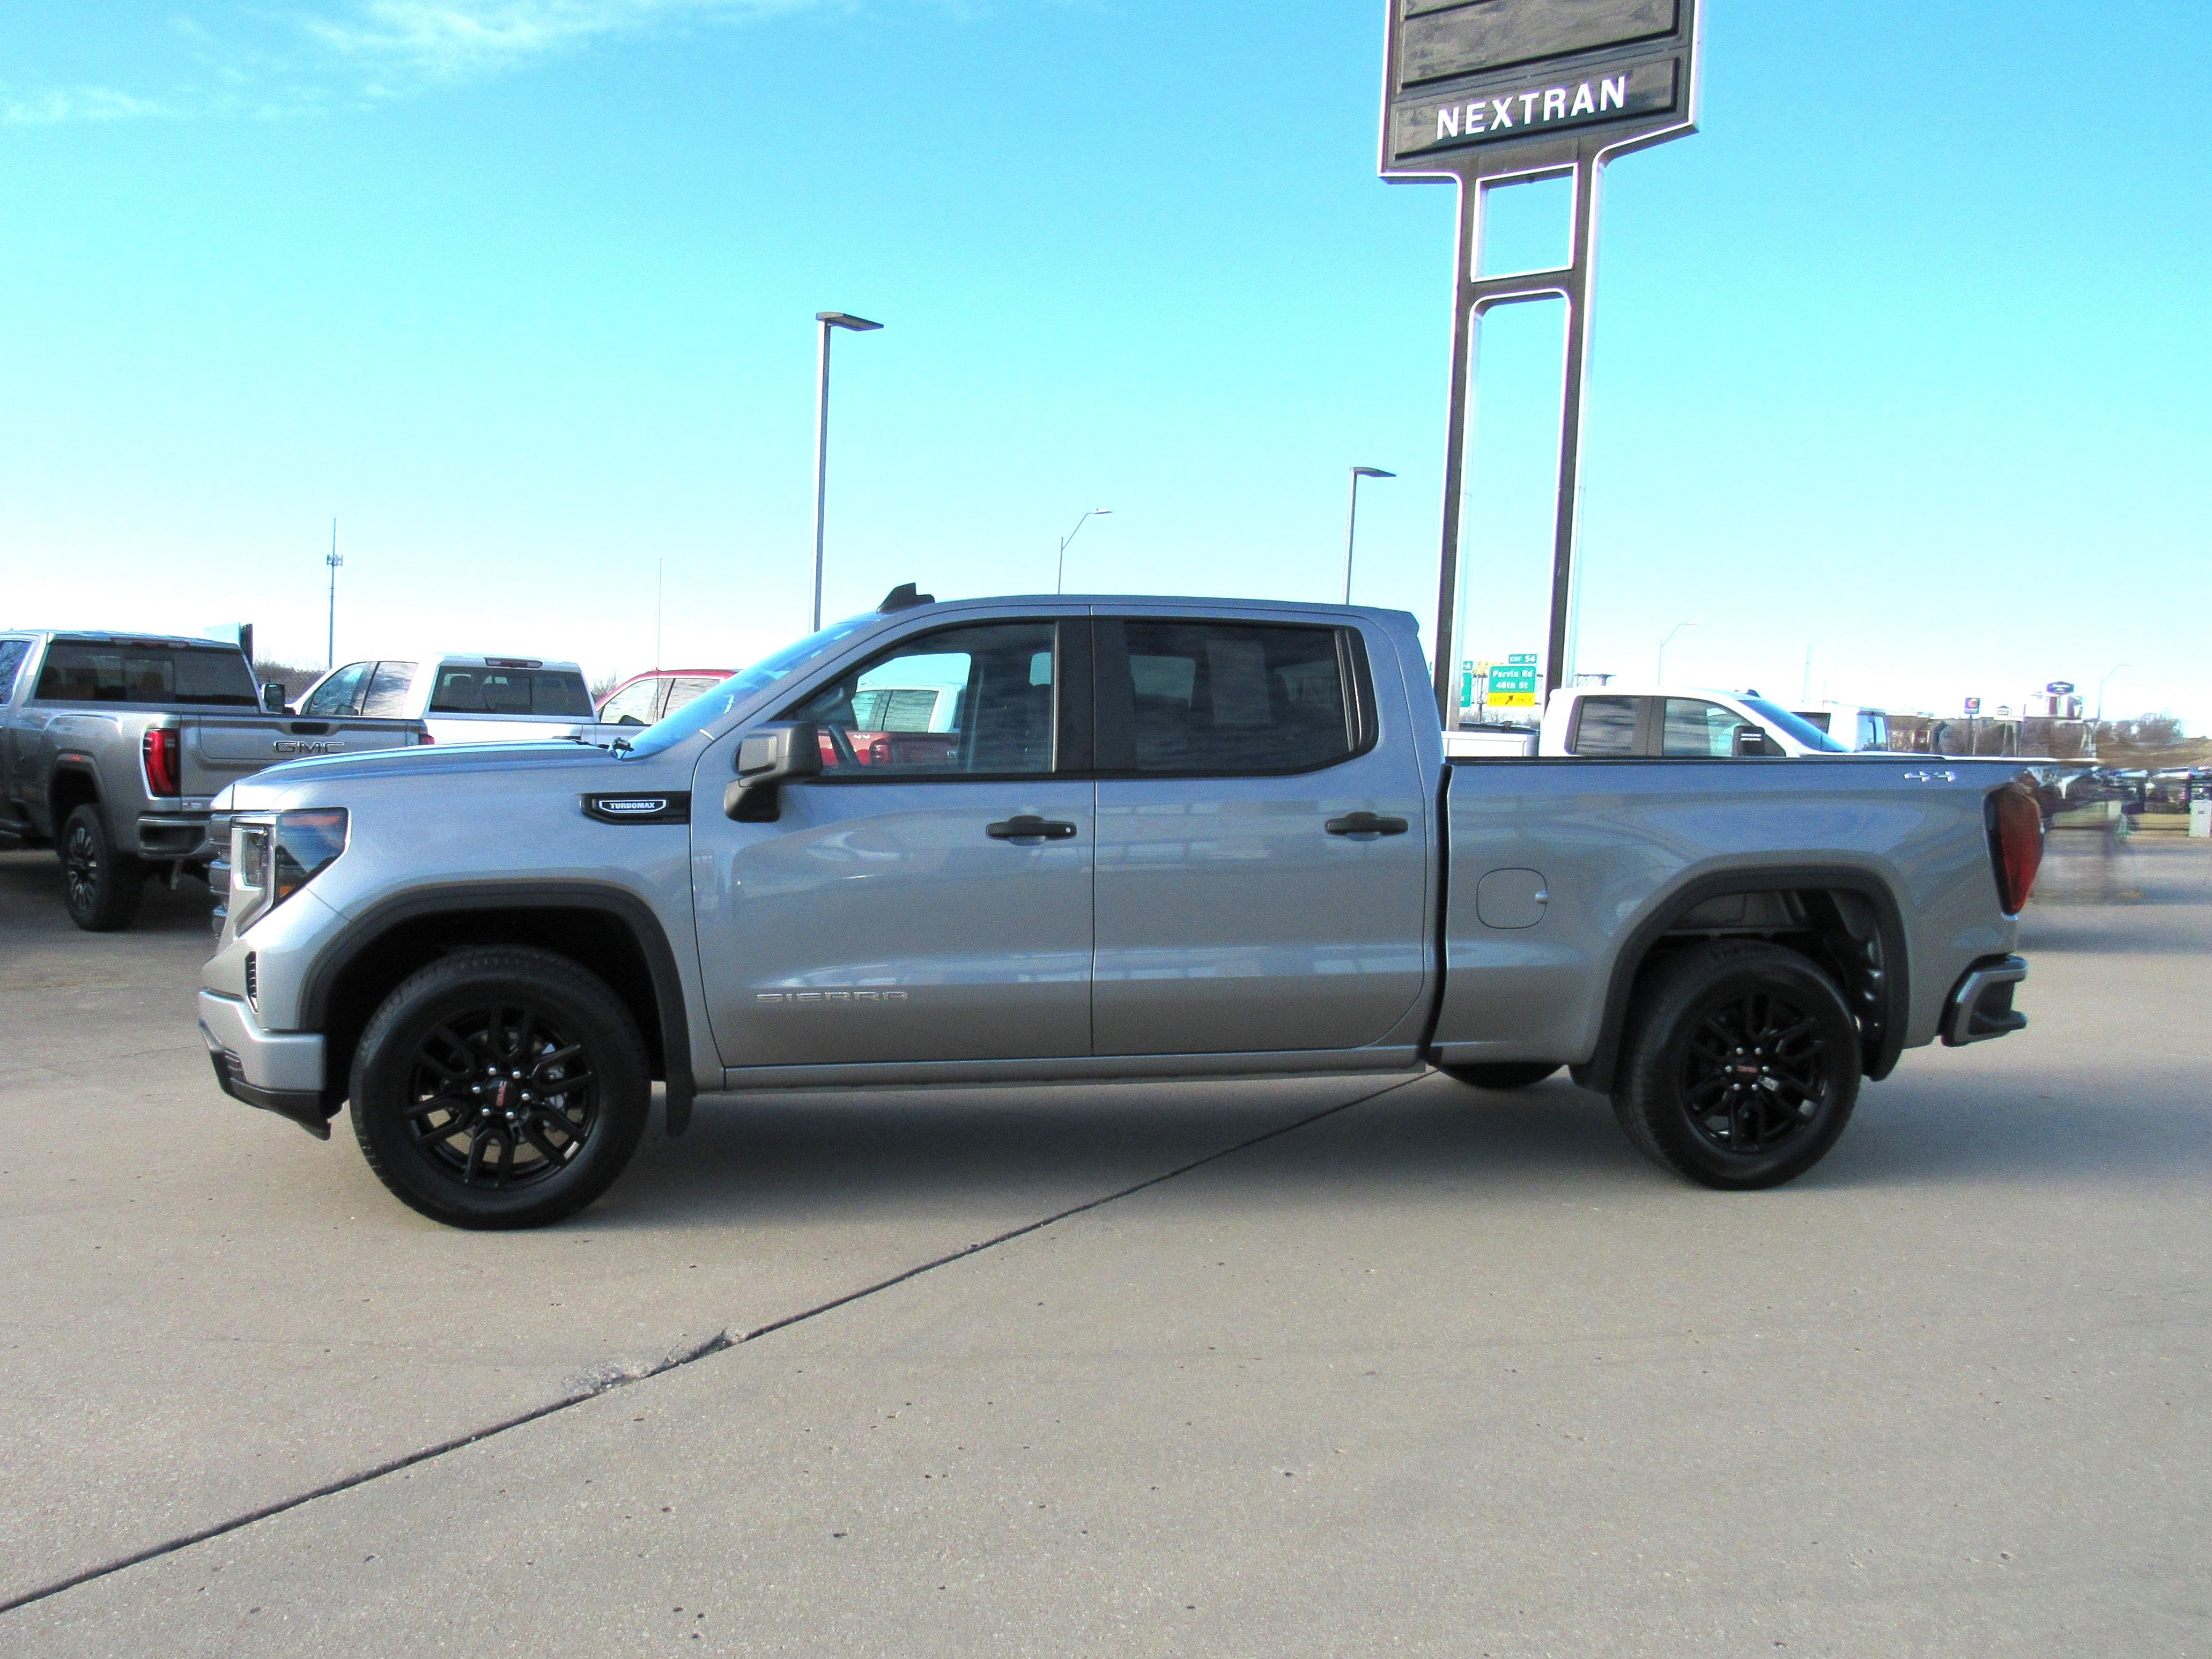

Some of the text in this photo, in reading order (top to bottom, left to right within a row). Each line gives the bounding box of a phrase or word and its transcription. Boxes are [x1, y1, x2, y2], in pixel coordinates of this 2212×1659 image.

[1436, 76, 1626, 140] NEXTRAN
[1492, 670, 1519, 678] Parvin
[1521, 670, 1533, 678] Rd
[1519, 680, 1528, 689] St
[273, 740, 345, 753] GMC
[756, 991, 909, 1002] SIERRA
